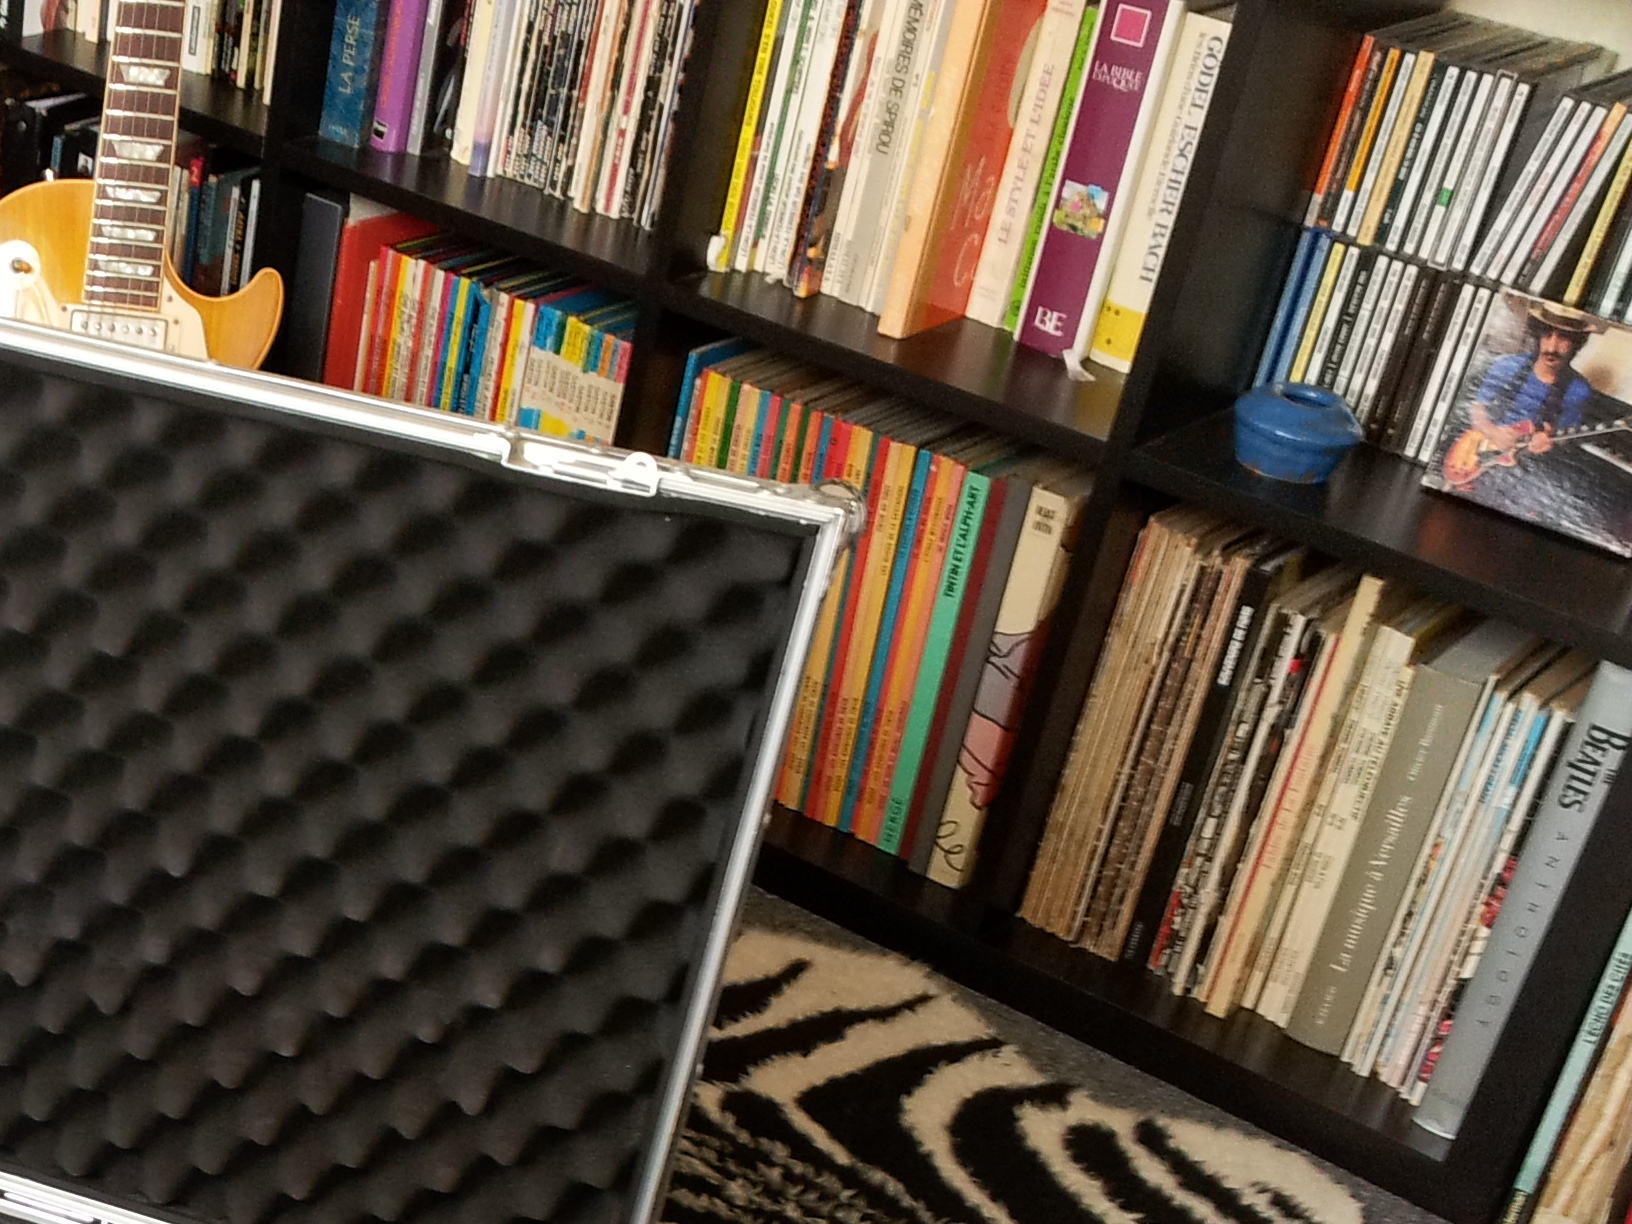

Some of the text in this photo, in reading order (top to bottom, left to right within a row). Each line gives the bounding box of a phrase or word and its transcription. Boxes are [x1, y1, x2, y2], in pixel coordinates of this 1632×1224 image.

[338, 14, 361, 93] LA PERSE
[1094, 60, 1143, 81] LA BIBLE
[887, 76, 905, 98] DE
[874, 99, 900, 155] SPIROU
[996, 219, 1012, 244] LE
[1004, 157, 1029, 217] STYLE
[1020, 129, 1037, 154] ET
[1136, 34, 1226, 284] GÖDEL ESCHER BACH
[1034, 305, 1067, 337] BE
[942, 563, 961, 598] TINTIN
[951, 548, 964, 562] ET
[1559, 723, 1628, 813] BEATLES
[1367, 791, 1413, 869] Versailles
[1338, 880, 1383, 951] musique
[1329, 949, 1353, 973] La
